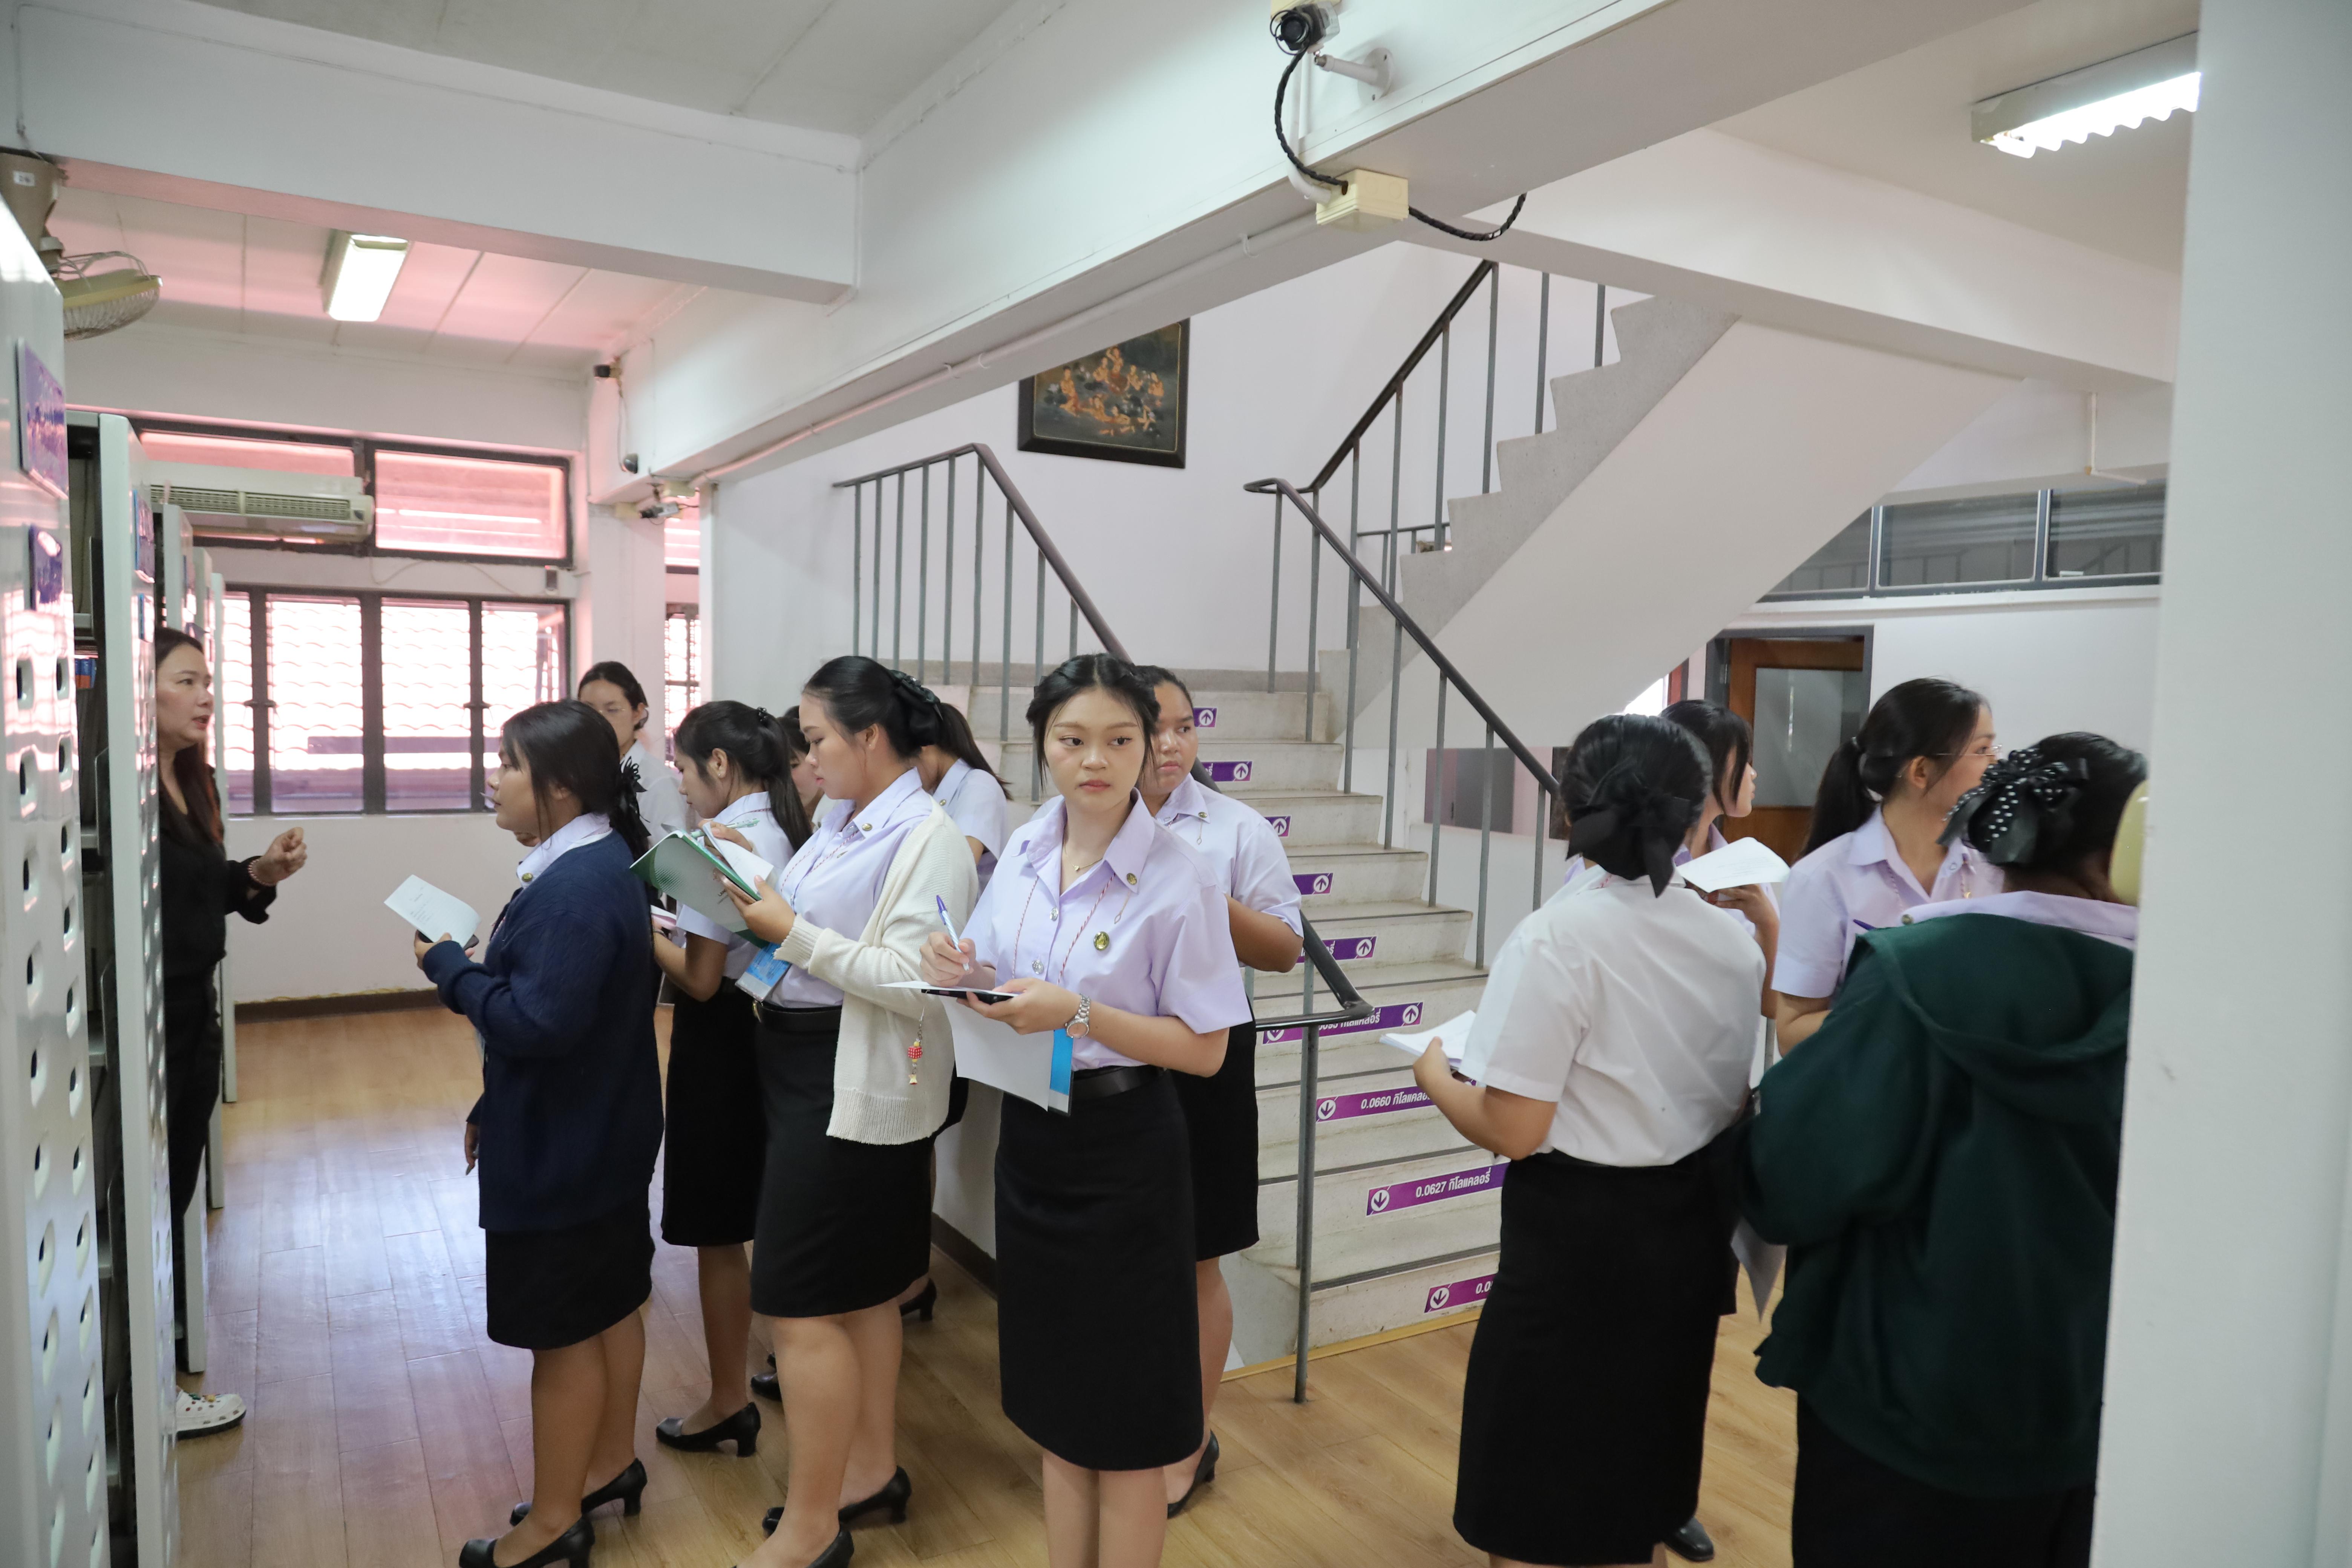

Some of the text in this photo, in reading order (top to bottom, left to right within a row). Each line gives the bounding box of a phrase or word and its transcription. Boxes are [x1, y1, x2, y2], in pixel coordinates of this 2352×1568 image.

[1361, 1092, 1430, 1109] 0.0660 กิโลแคลอ
[1416, 1167, 1491, 1198] 0.0627 กิโลแคลอรี่
